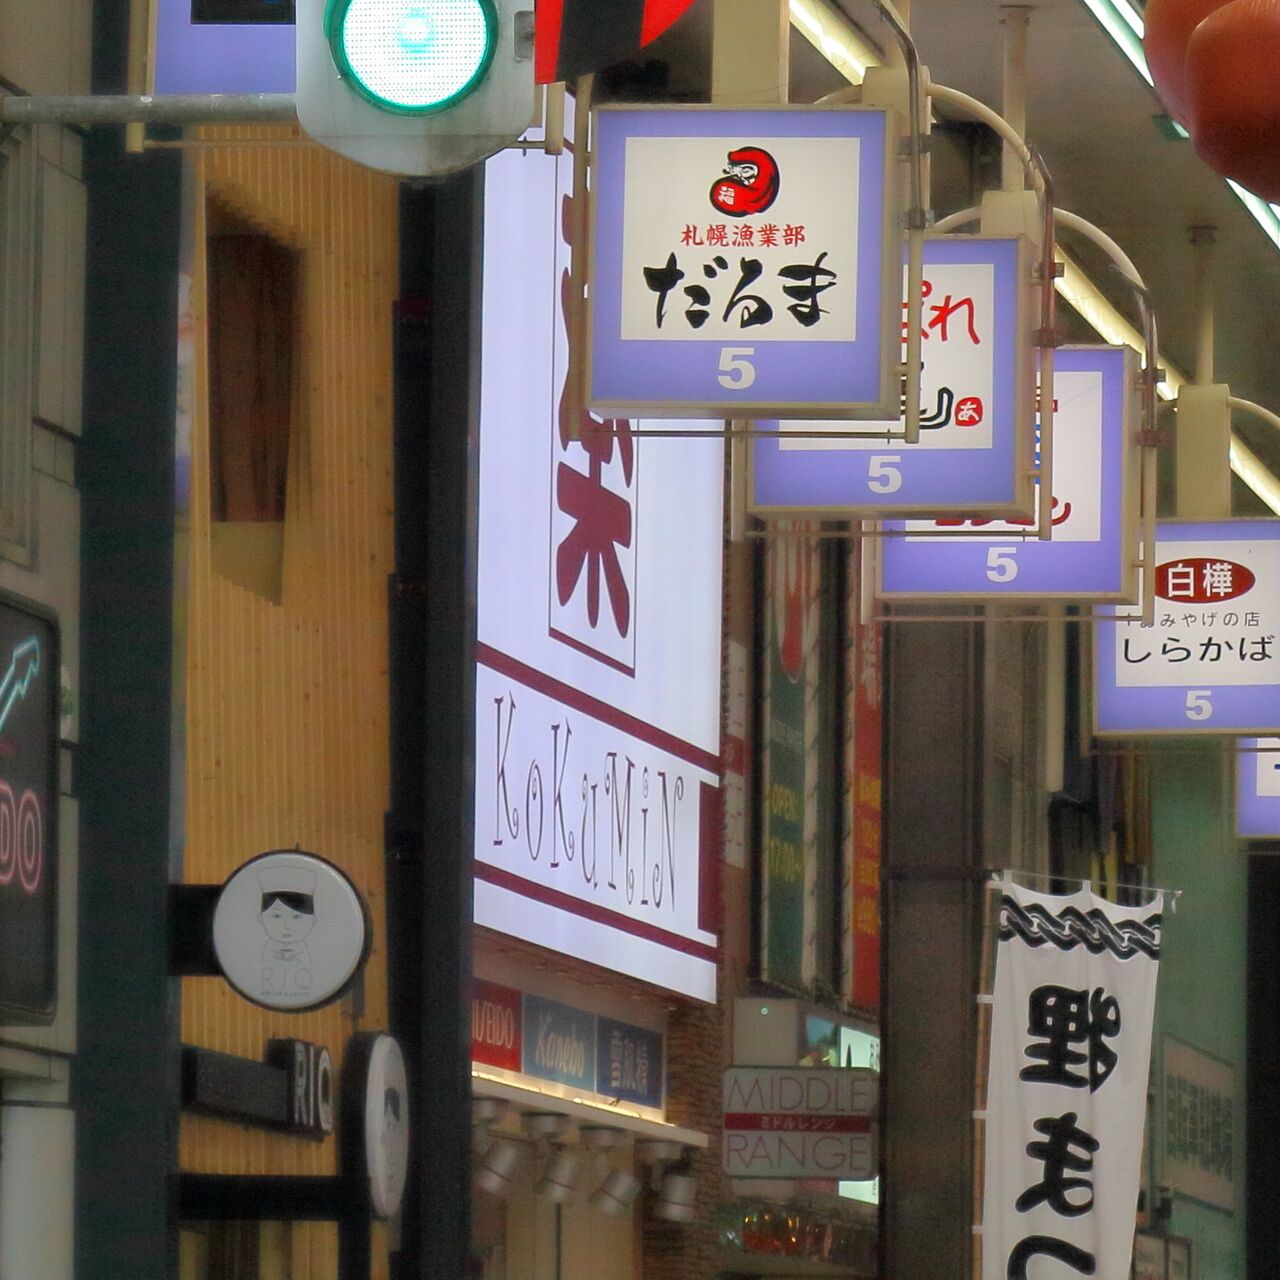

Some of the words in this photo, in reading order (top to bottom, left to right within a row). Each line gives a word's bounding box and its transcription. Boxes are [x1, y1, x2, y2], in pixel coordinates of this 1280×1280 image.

[680, 223, 806, 248] 札幌漁業部
[643, 252, 837, 329] だるま
[717, 347, 756, 390] 5
[959, 401, 980, 421] あ
[867, 456, 902, 494] 5
[986, 547, 1018, 583] 5
[1168, 563, 1232, 597] 白樺
[1124, 634, 1275, 664] しらかば
[1186, 689, 1213, 720] 5
[727, 1076, 867, 1113] MIDDLE
[727, 1134, 866, 1170] RANGE
